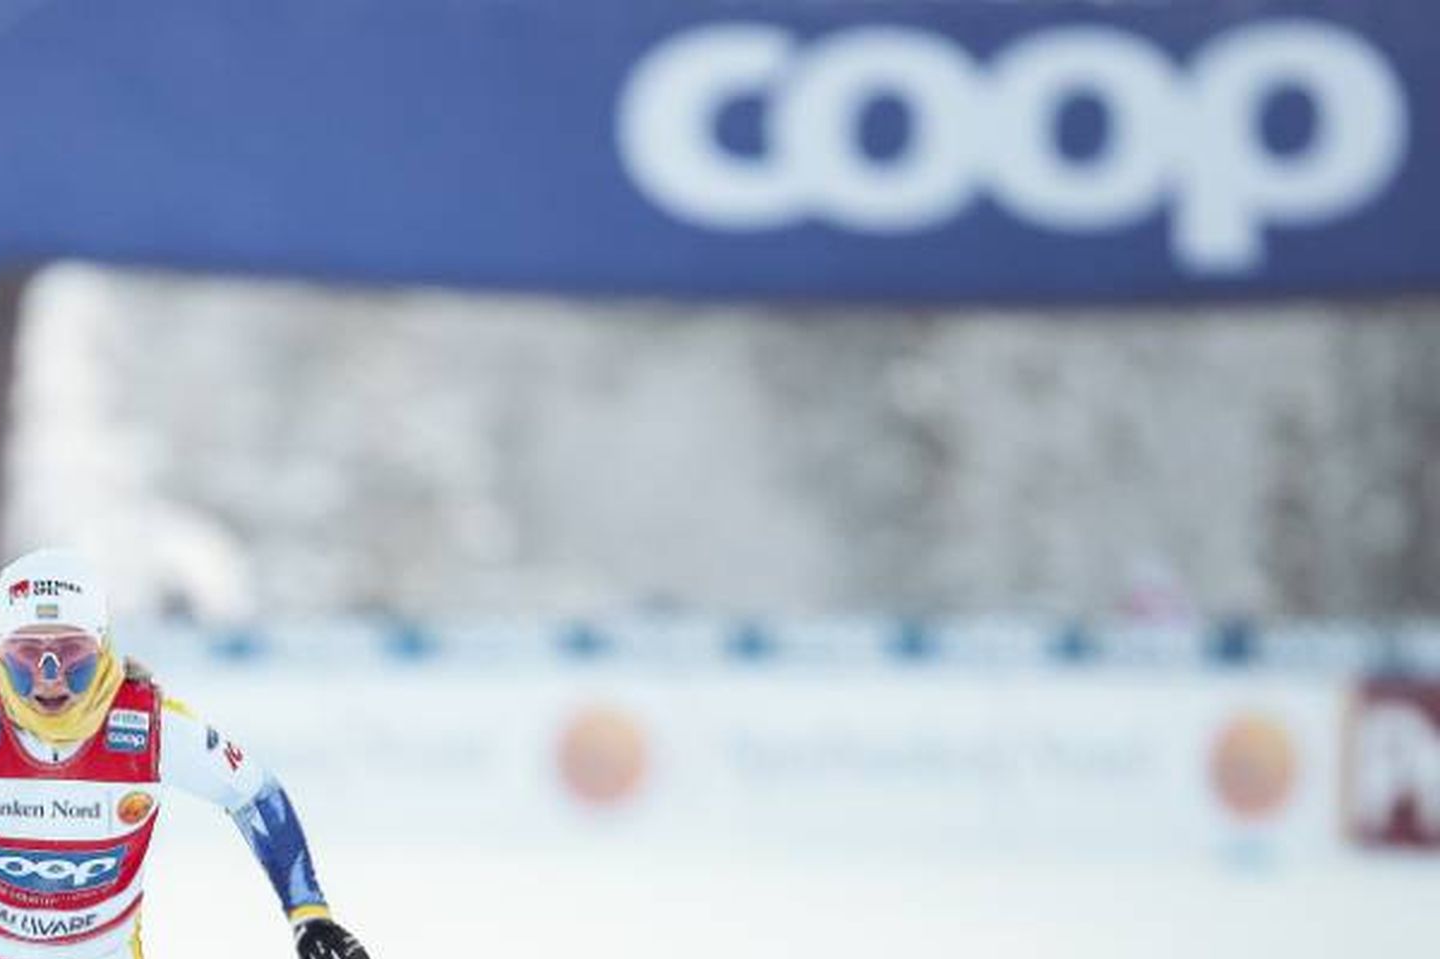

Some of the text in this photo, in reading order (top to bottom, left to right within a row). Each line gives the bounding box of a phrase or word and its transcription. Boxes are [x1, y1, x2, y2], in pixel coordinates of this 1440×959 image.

[618, 20, 1408, 274] coop
[108, 732, 145, 748] coop
[51, 800, 101, 819] Nord
